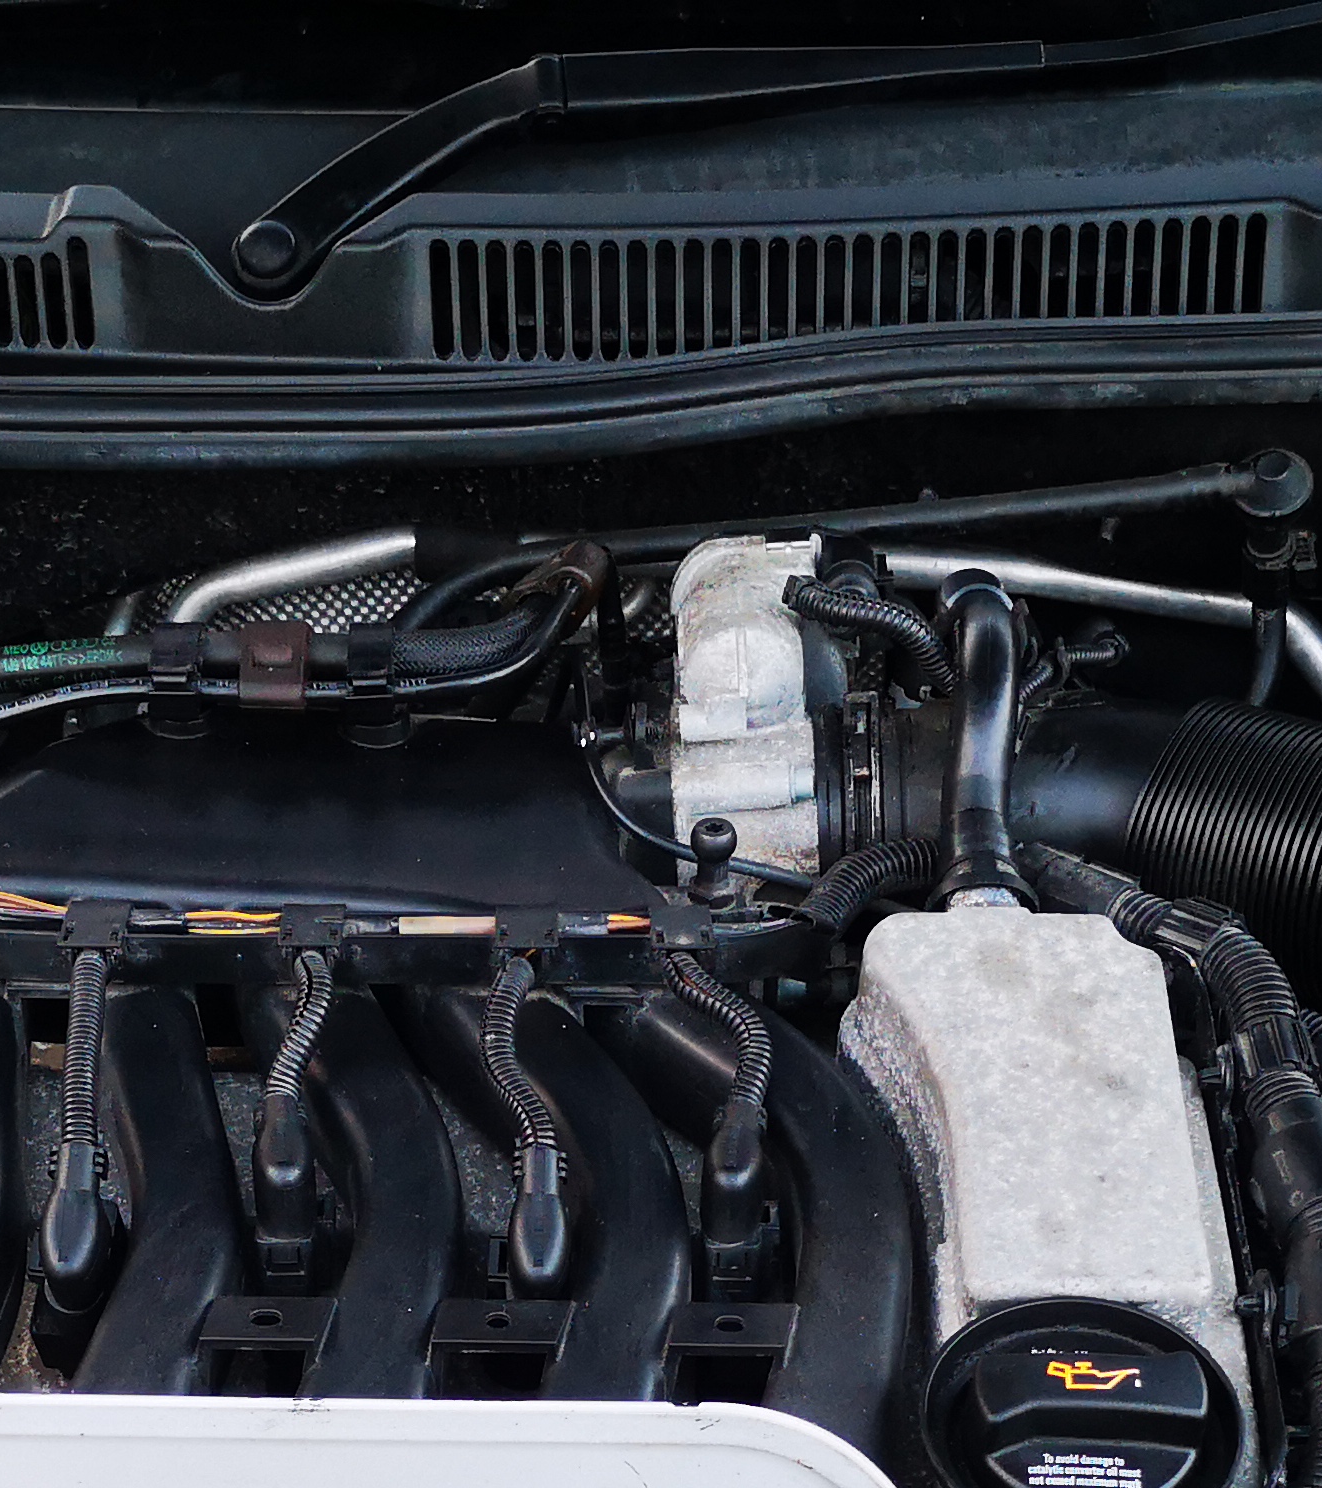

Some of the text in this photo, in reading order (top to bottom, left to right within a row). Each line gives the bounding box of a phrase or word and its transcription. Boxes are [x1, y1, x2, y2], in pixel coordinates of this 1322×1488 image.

[1042, 1453, 1125, 1467] To avoid damage to
[1027, 1464, 1142, 1478] catalytic converter oil must
[1028, 1475, 1142, 1488] not exceed maximum mark
